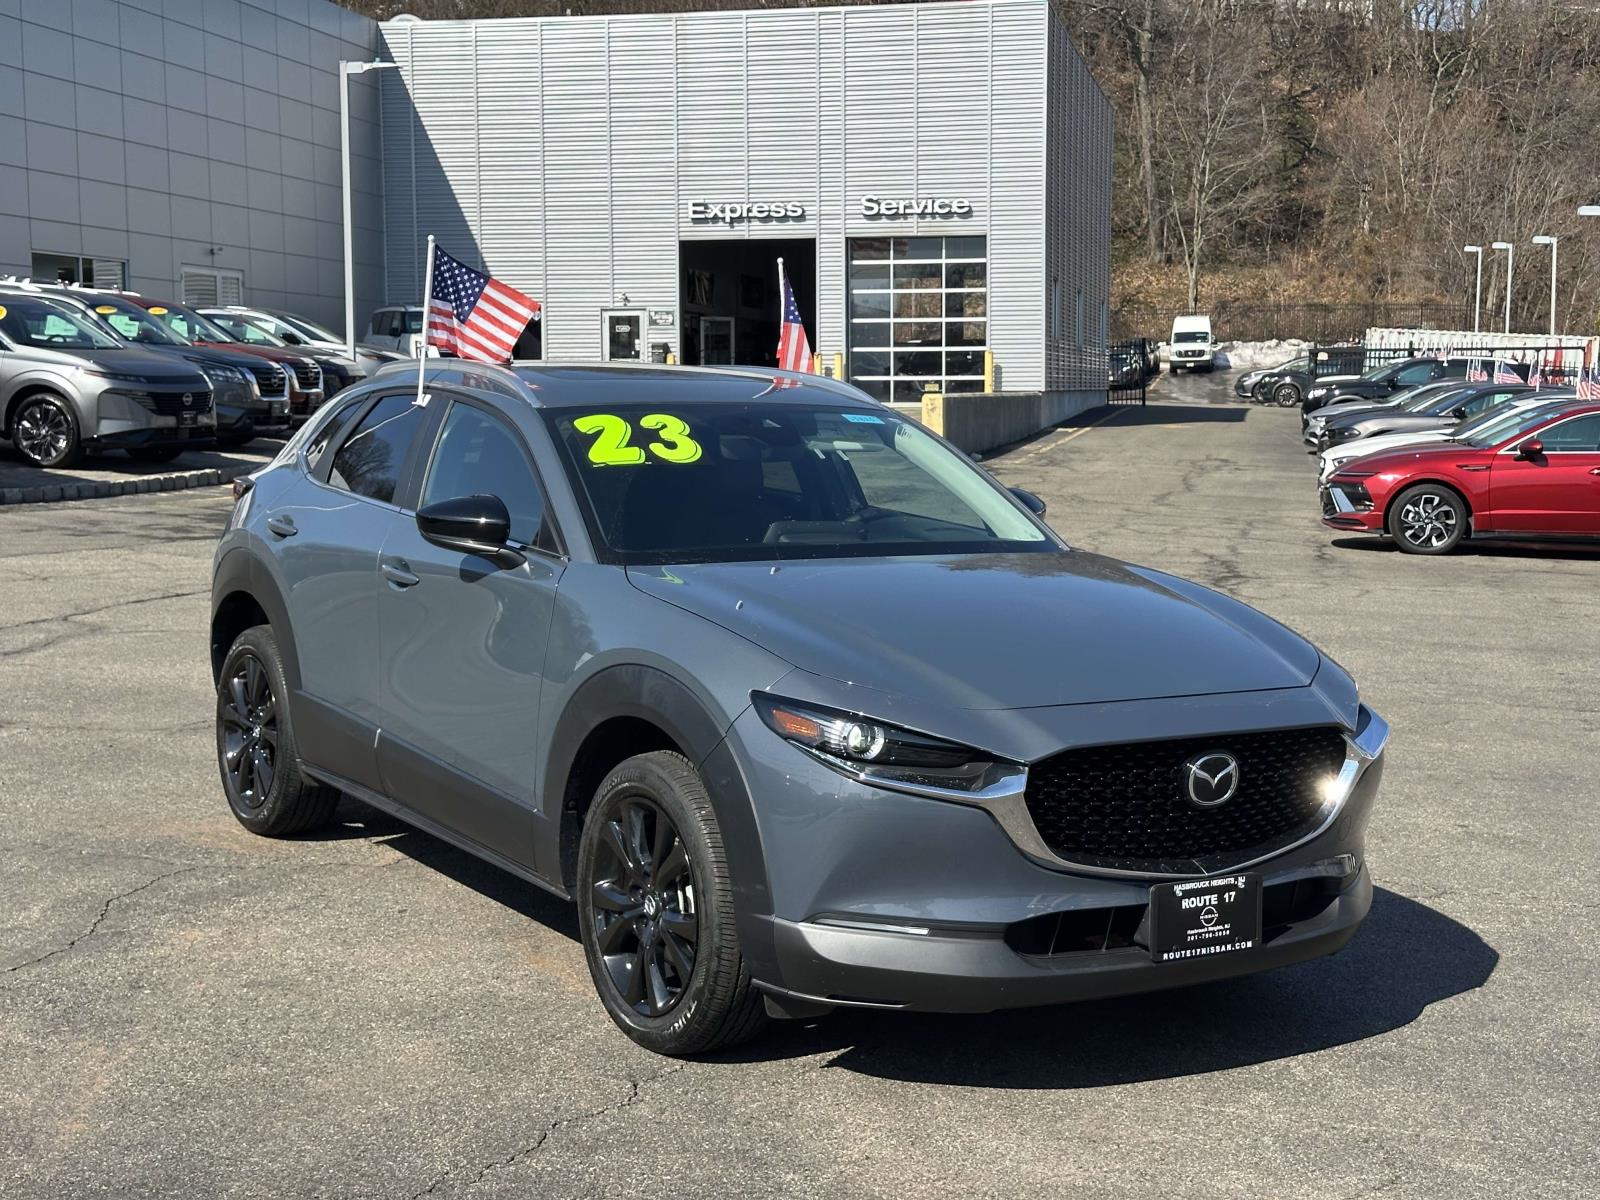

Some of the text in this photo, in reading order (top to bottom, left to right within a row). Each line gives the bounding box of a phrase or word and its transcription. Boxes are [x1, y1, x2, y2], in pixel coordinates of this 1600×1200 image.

[688, 194, 971, 223] Express Service
[573, 413, 702, 465] 23
[1174, 880, 1210, 892] HASBROUCK
[1181, 891, 1236, 909] ROUTE 17
[1163, 941, 1252, 960] ROUTE17NISSAN.COM
